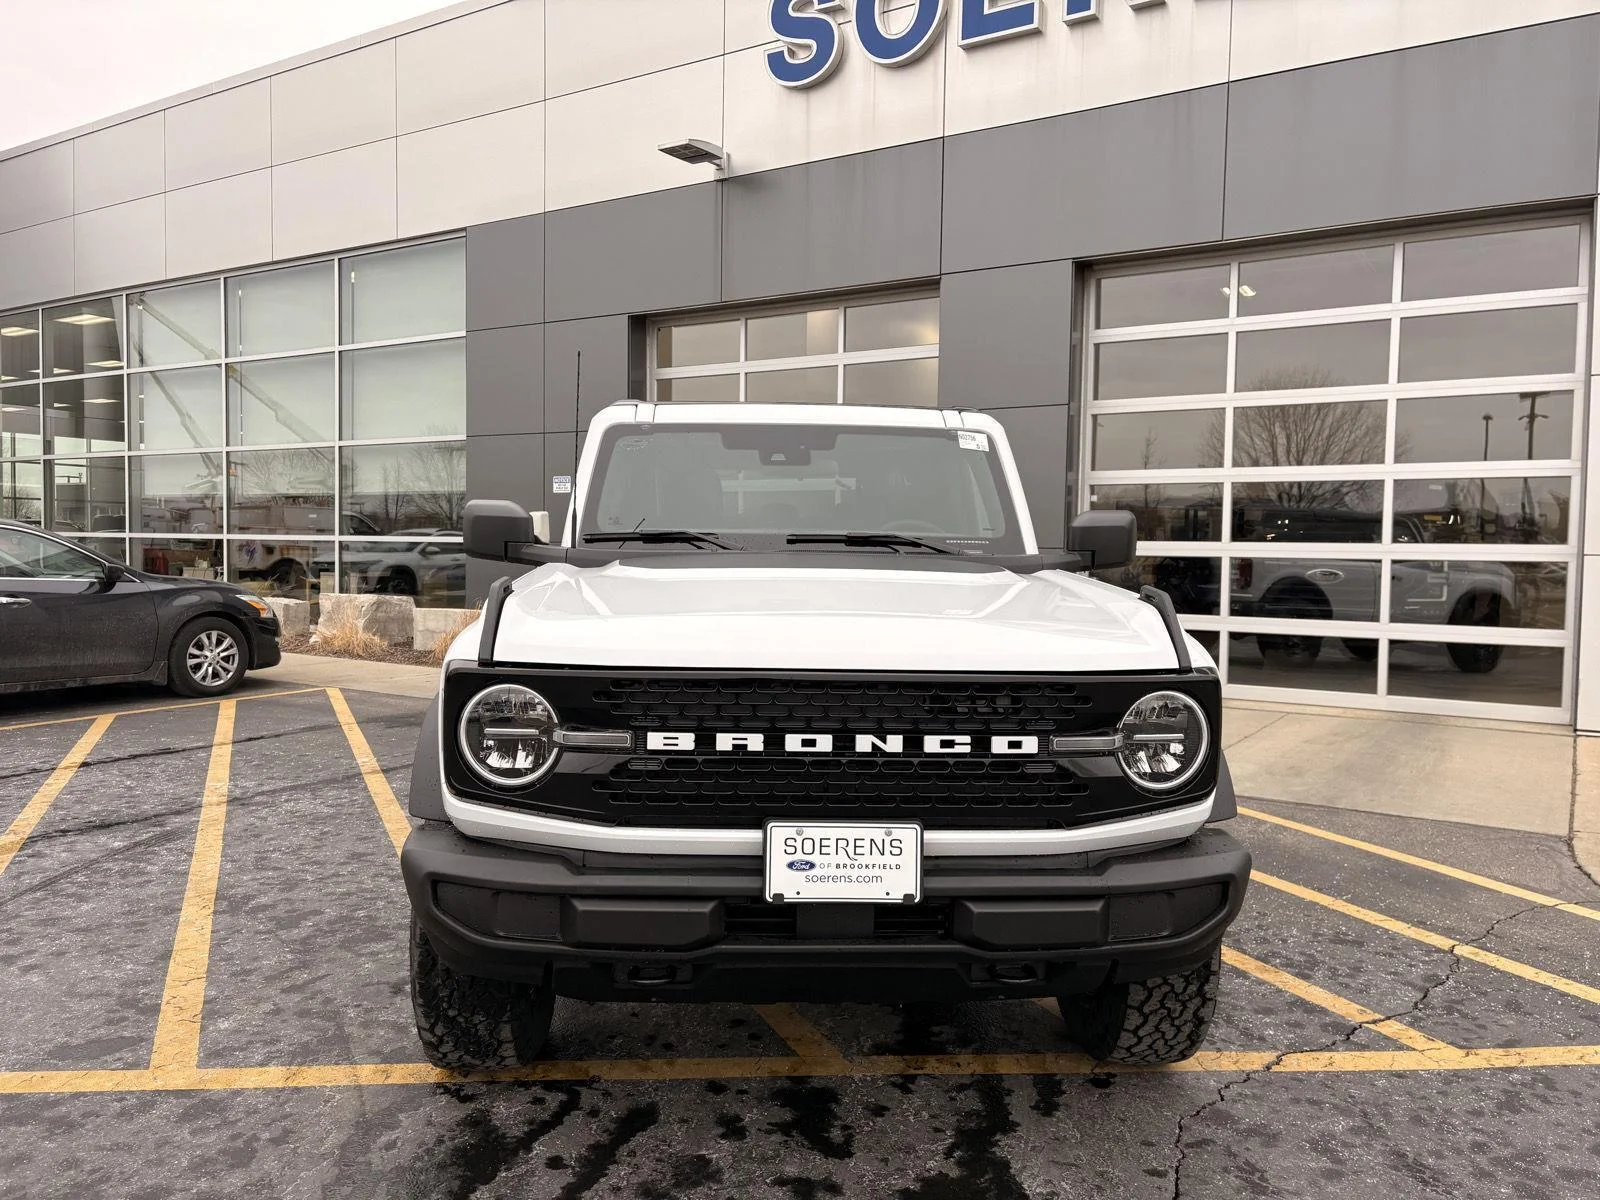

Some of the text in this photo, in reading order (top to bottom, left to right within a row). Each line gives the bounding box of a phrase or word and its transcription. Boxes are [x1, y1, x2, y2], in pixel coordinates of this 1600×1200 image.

[646, 732, 1039, 754] BRONCO
[784, 837, 903, 861] SOERENS
[790, 860, 813, 871] Ford
[819, 862, 832, 870] OF
[804, 874, 883, 884] soerens.com
